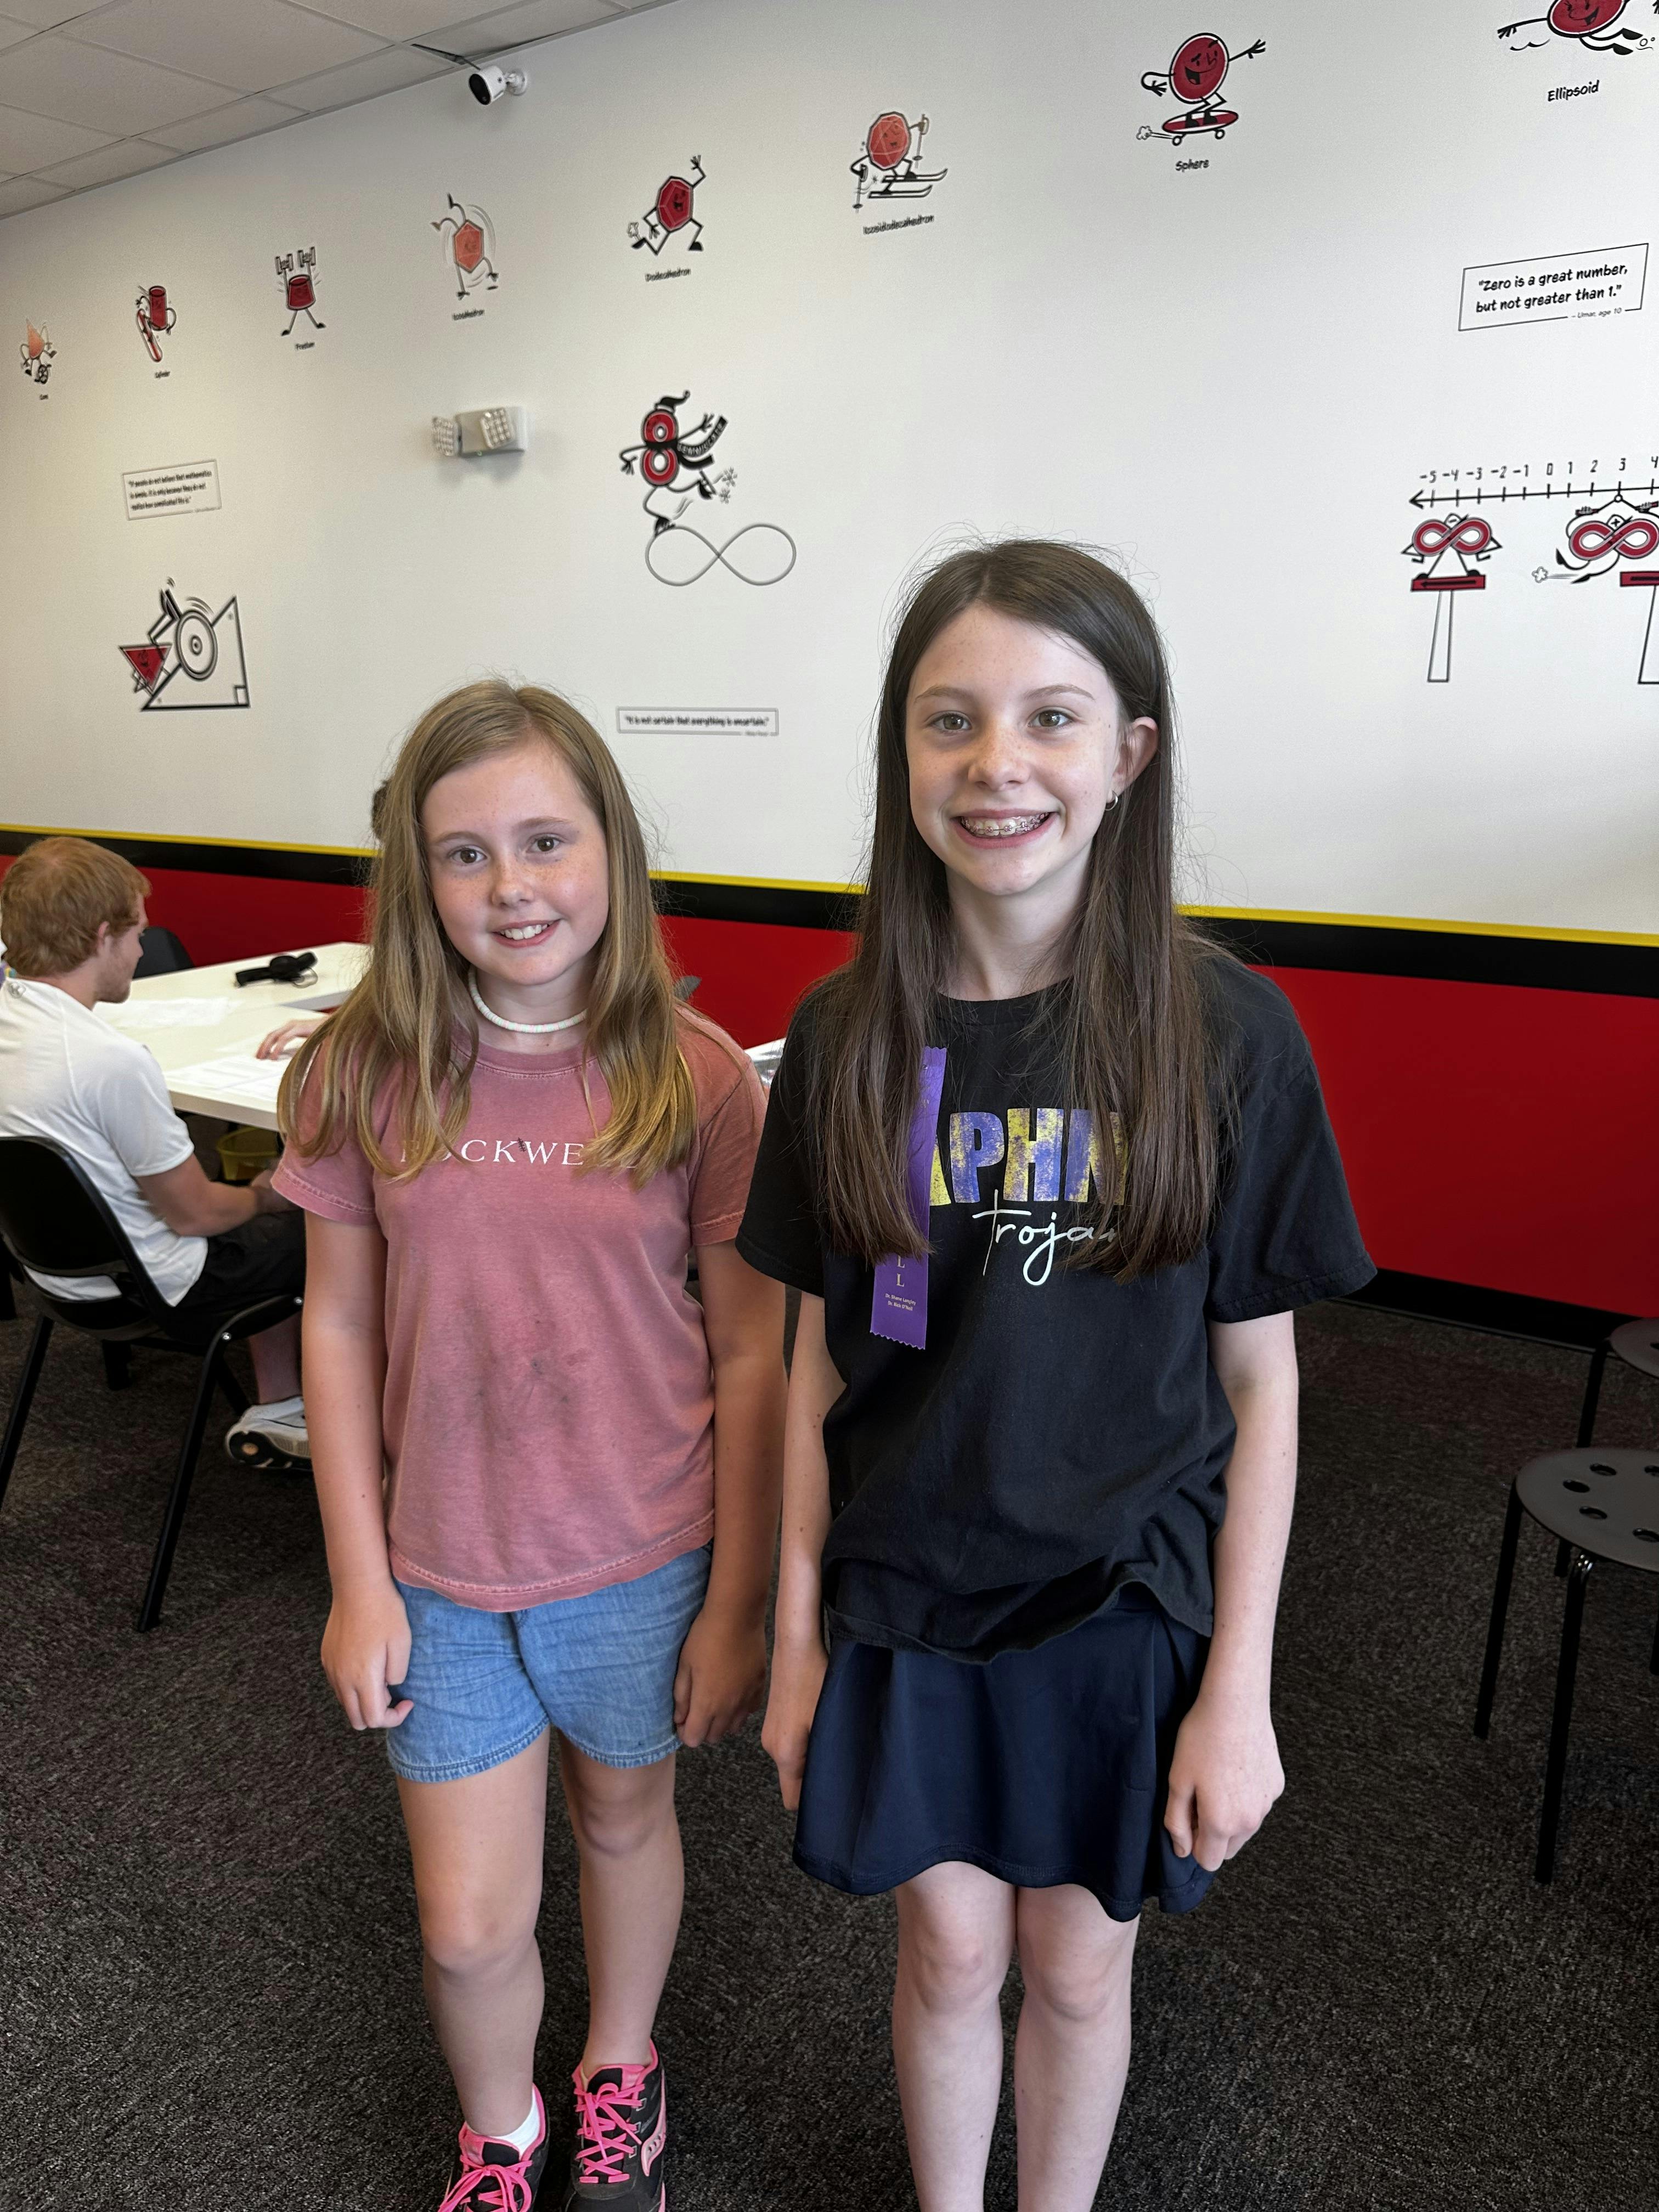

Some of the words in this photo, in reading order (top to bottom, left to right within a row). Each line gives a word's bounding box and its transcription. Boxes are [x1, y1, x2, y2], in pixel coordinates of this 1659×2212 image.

[1548, 79, 1600, 101] Ellipsoid
[1176, 159, 1210, 173] Sphere
[1514, 275, 1525, 287] is
[1527, 276, 1536, 286] a
[1538, 269, 1573, 287] great
[1576, 264, 1628, 280] number,
[1476, 299, 1498, 313] but
[1499, 296, 1522, 311] not
[1524, 291, 1572, 309] greater
[1575, 288, 1605, 301] than
[1419, 470, 1437, 483] -5
[1442, 469, 1459, 482] -4
[1466, 467, 1482, 481] -3
[1491, 465, 1507, 479] -2
[1513, 464, 1529, 477] -1
[1546, 462, 1554, 476] 0
[1567, 461, 1573, 475] 1
[1590, 459, 1599, 473] 2
[1618, 458, 1626, 471] 3
[1651, 456, 1658, 469] 4
[400, 1139, 636, 1169] CKWE
